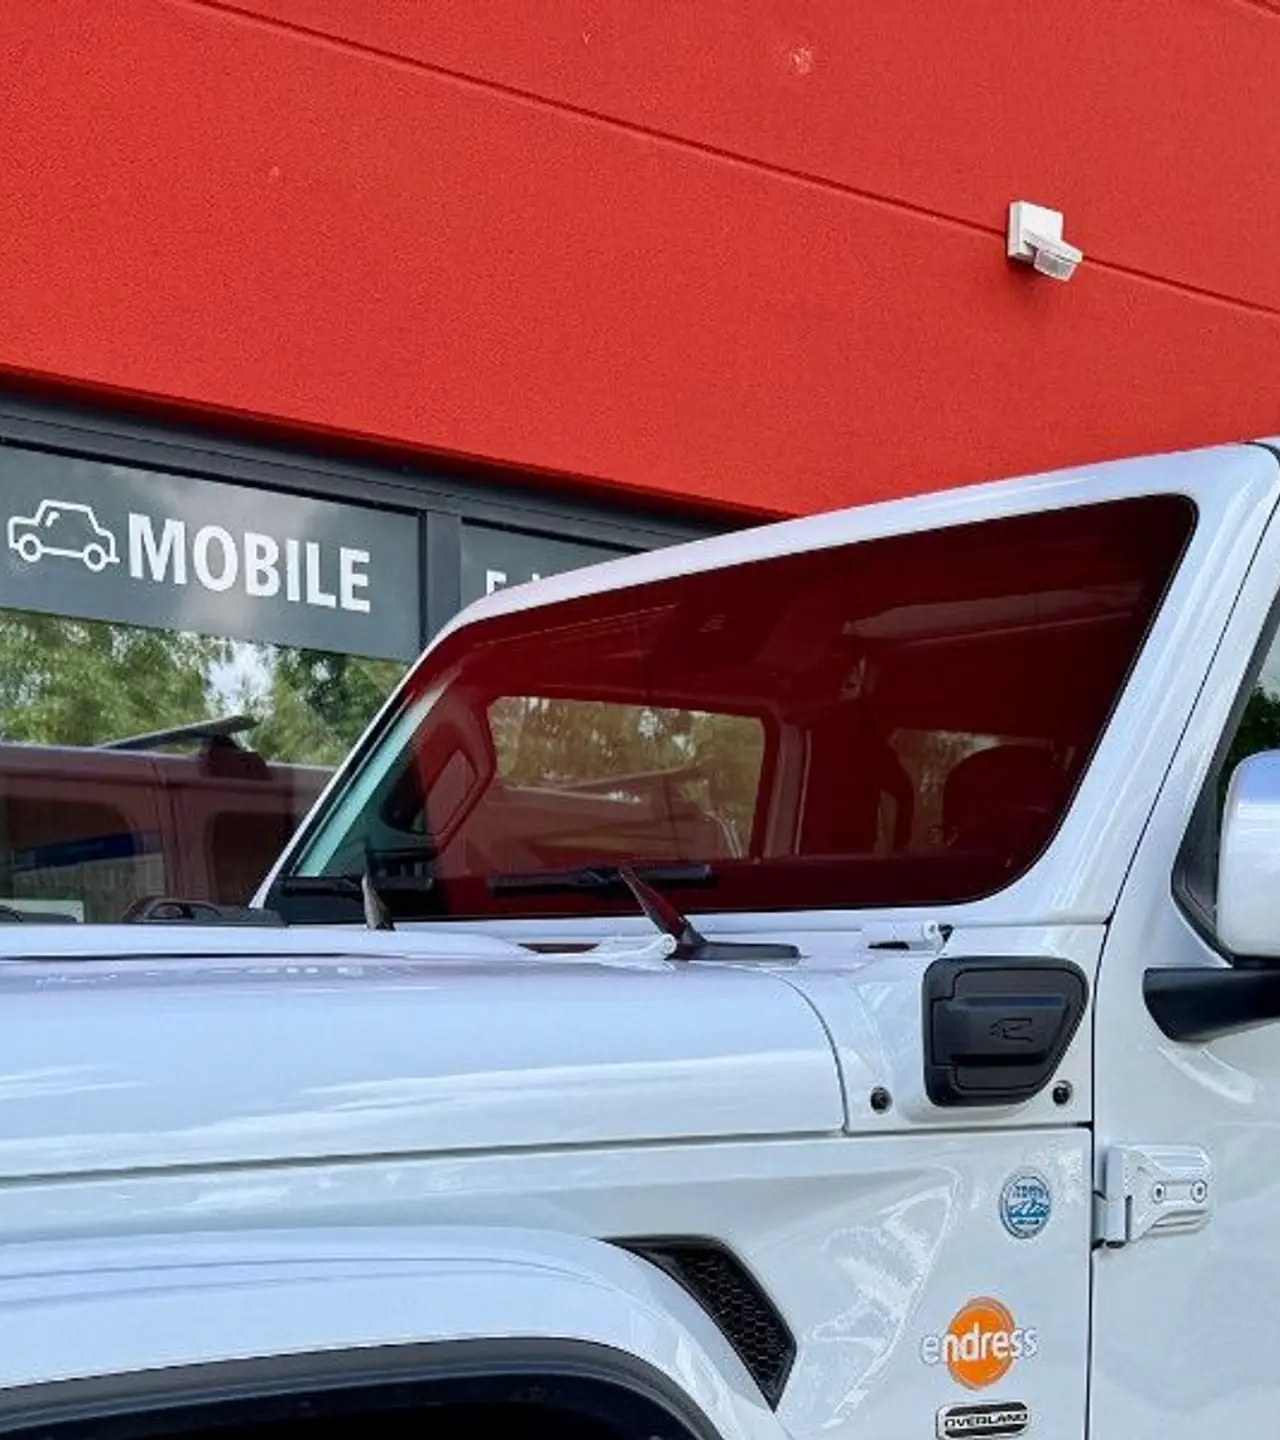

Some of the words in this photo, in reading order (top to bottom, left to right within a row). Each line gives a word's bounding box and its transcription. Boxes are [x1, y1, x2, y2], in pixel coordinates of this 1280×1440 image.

[128, 512, 371, 614] MOBILE
[920, 1321, 1041, 1366] endress
[943, 1411, 1028, 1429] OVERLAND
